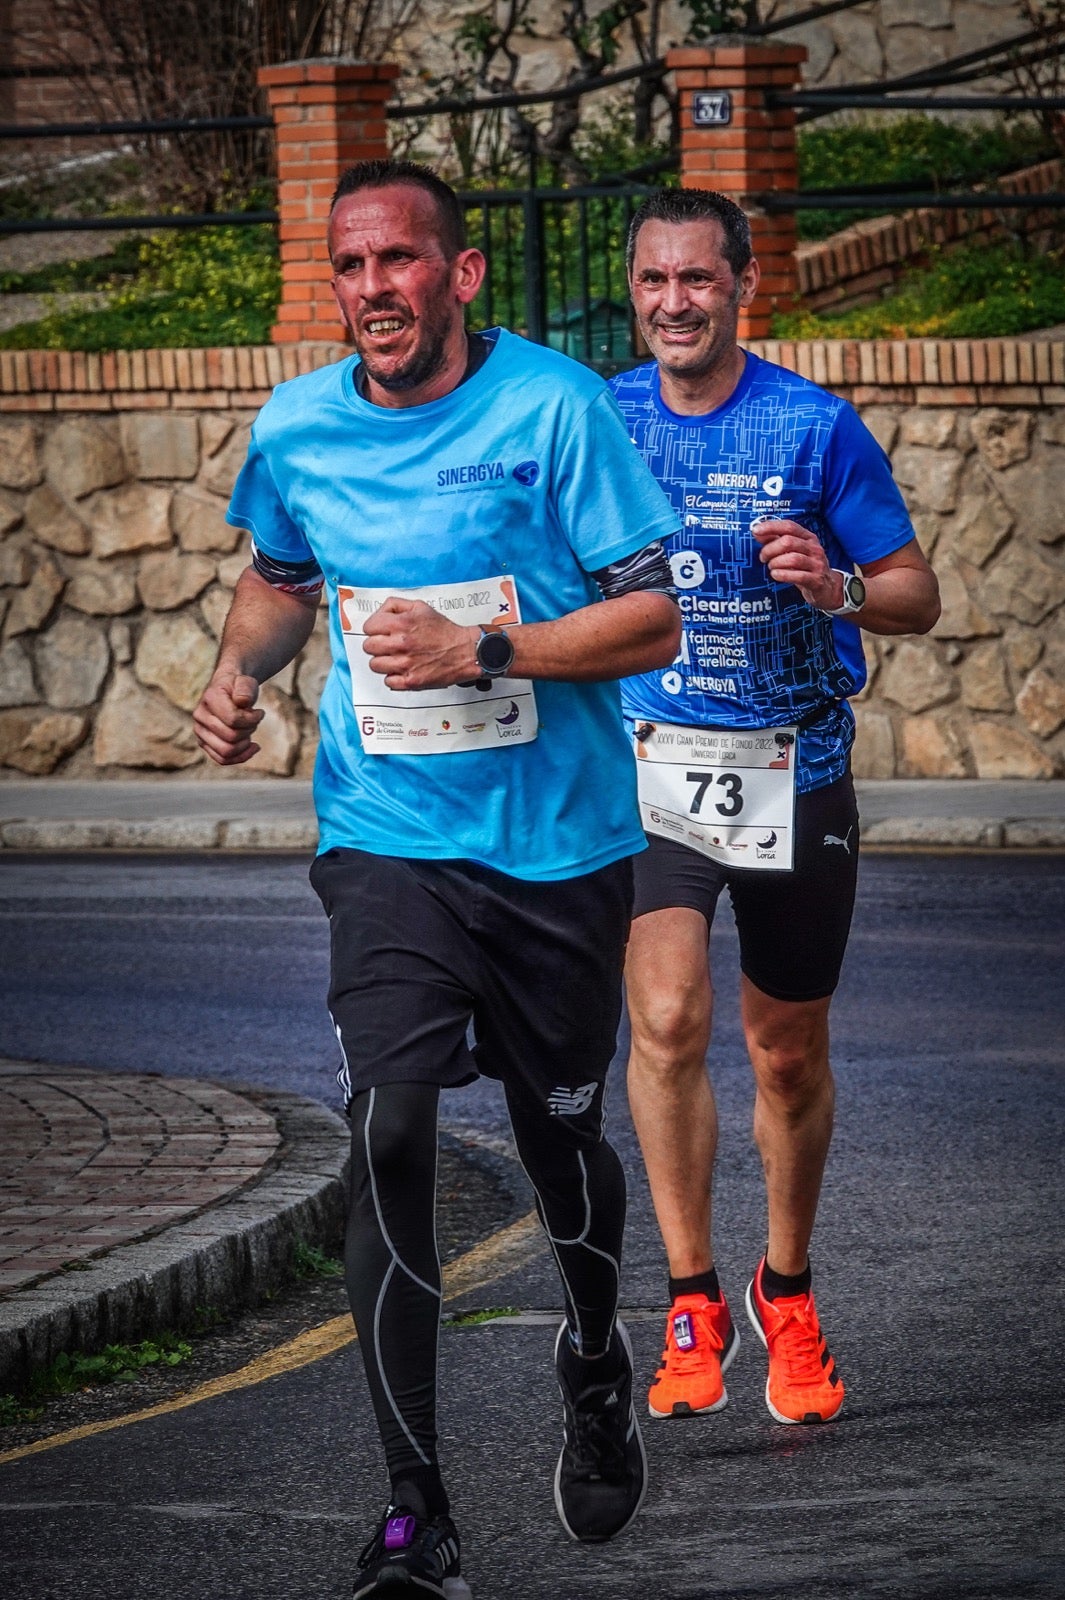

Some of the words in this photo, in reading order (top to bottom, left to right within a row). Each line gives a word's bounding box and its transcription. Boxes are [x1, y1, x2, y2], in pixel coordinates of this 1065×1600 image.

[699, 96, 723, 120] 37
[437, 462, 505, 487] SINERGYA
[707, 473, 758, 489] SINERGYA
[752, 499, 791, 507] Imagen
[467, 591, 491, 608] 2022
[678, 595, 772, 613] Cleardent
[692, 613, 707, 622] Dr.
[708, 613, 737, 625] Ismael
[738, 614, 770, 624] Cerezo
[689, 630, 744, 646] farmacia
[696, 643, 746, 657] alaminos
[698, 655, 749, 668] arellano
[496, 724, 522, 738] Lorca
[657, 733, 675, 745] XXXV
[755, 738, 773, 750] 2022
[686, 771, 744, 817] 73
[756, 847, 776, 859] Lorca
